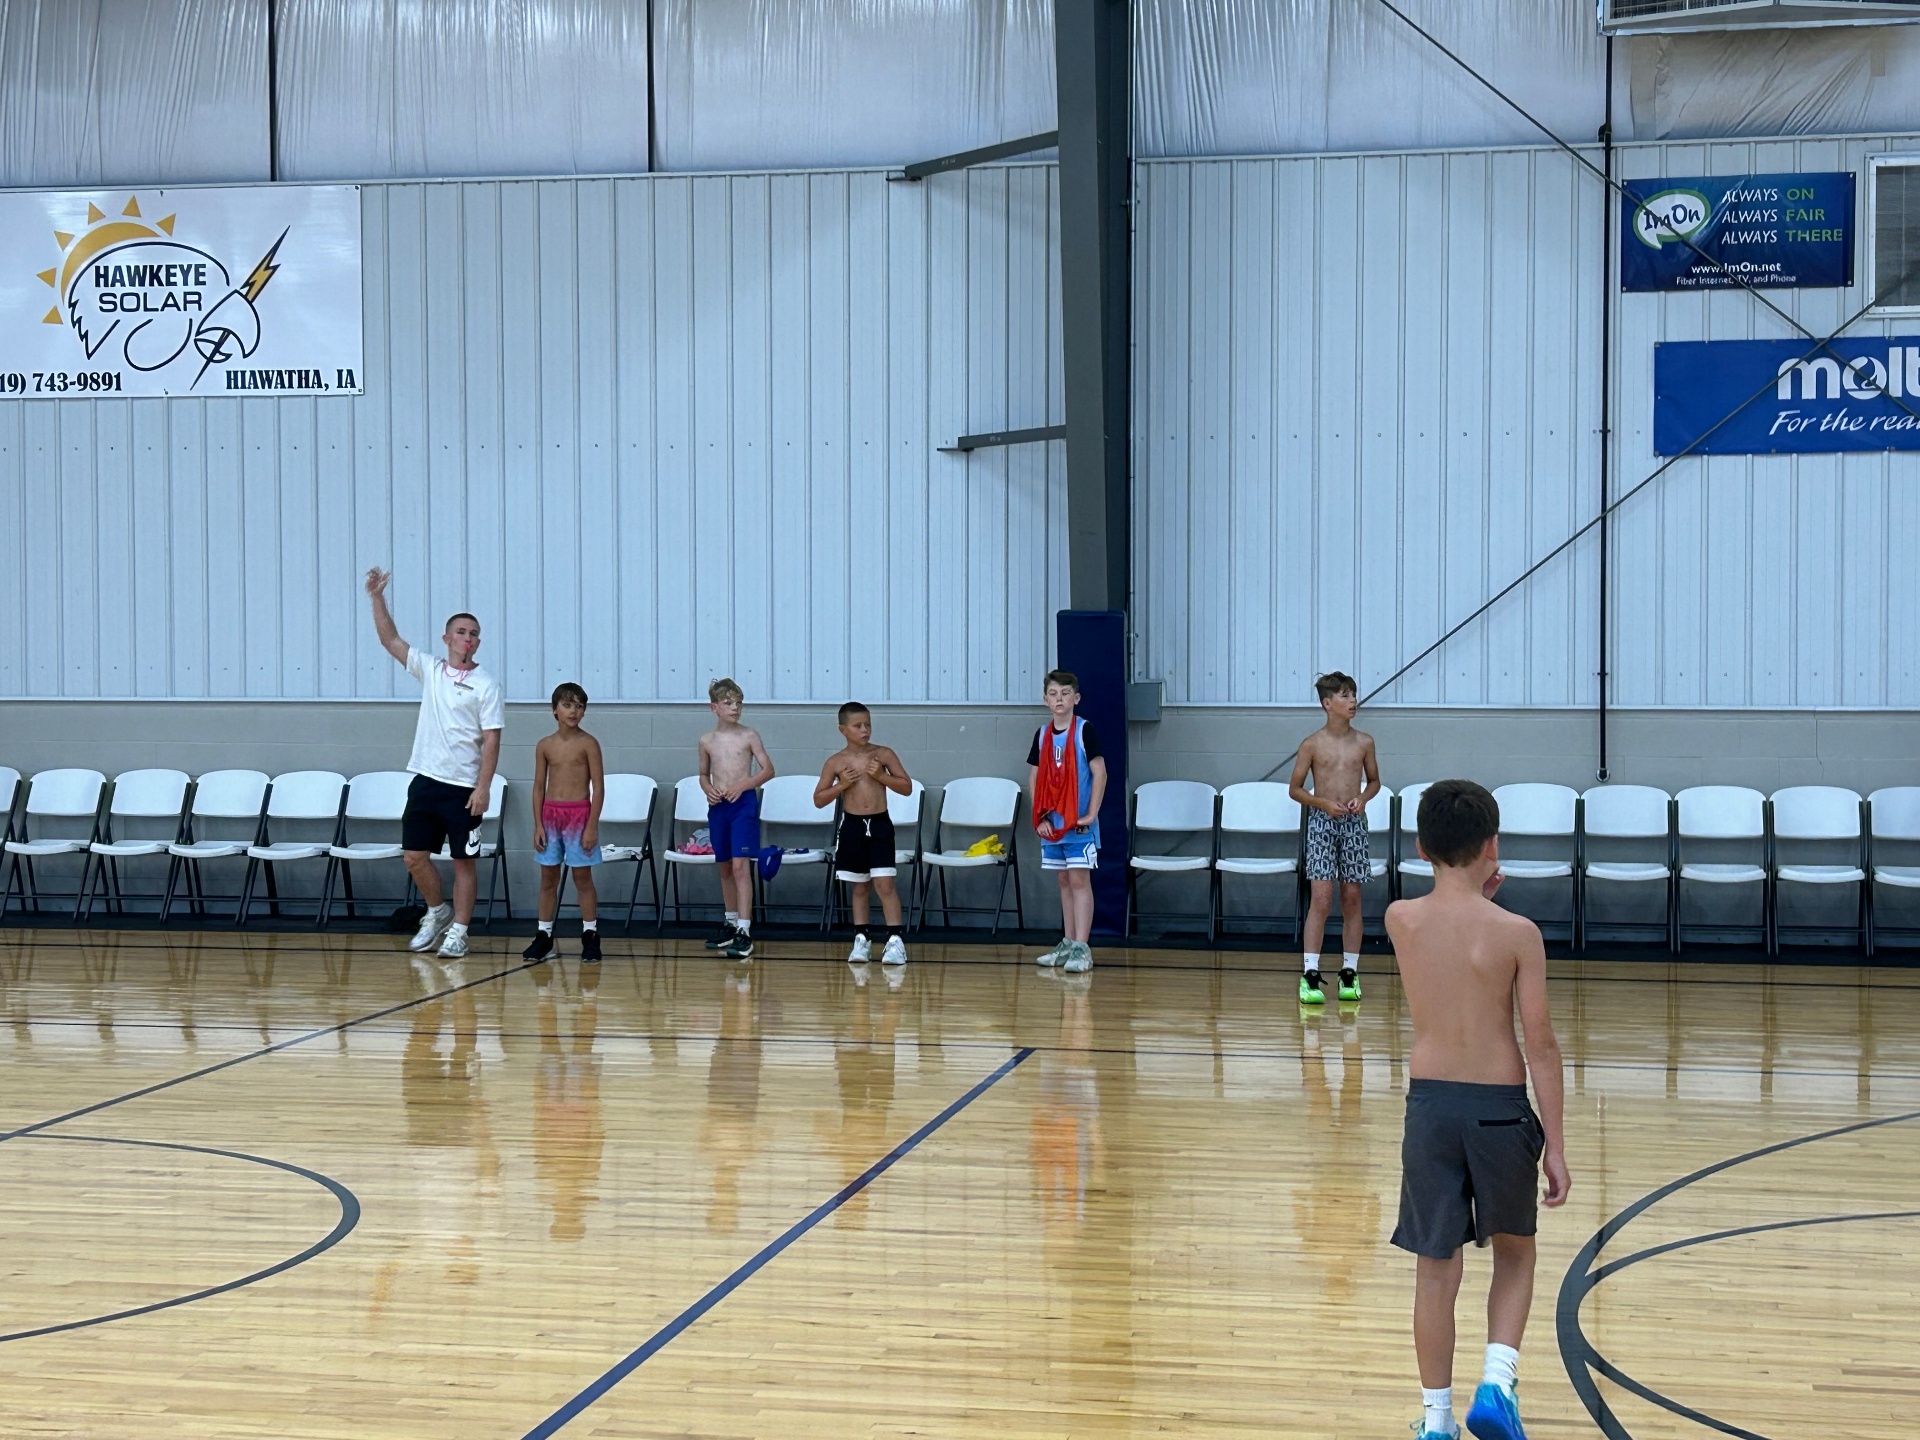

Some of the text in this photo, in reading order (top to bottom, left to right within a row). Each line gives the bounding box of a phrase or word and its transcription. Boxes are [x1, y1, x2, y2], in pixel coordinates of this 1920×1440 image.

[1723, 187, 1815, 203] ALWAYS ON
[1643, 203, 1701, 231] ImOn
[1721, 208, 1825, 224] ALWAYS FAIR
[1721, 229, 1843, 245] ALWAYS THERE
[94, 263, 208, 289] HAWKEYE
[1770, 273, 1797, 283] Phone
[98, 290, 203, 313] SOLAR
[32, 371, 122, 392] 743-9891
[225, 369, 357, 391] HIAWATHA, IA
[1768, 407, 1920, 435] For the rea
